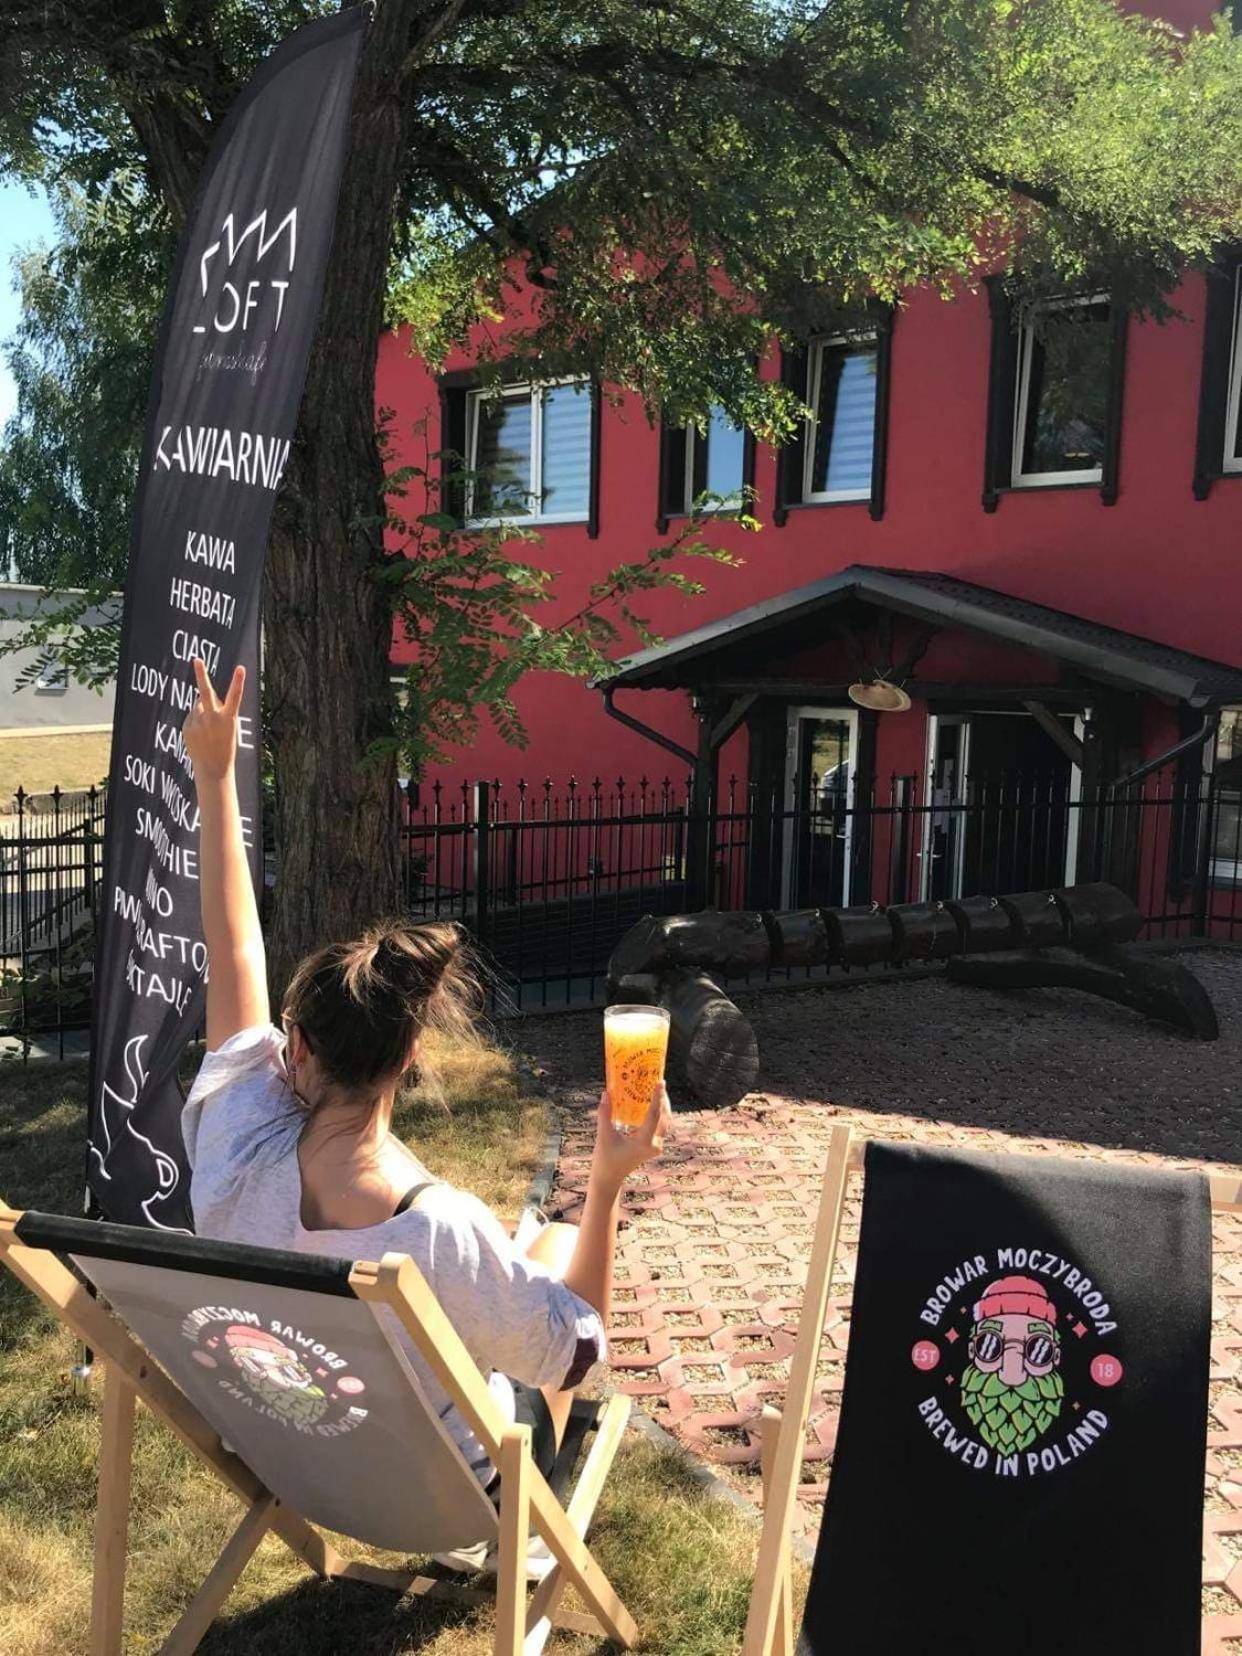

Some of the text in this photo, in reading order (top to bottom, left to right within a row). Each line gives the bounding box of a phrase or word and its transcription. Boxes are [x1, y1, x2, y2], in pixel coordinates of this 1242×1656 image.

[184, 530, 236, 575] KAWA
[170, 576, 237, 630] HERBATA
[130, 662, 169, 701] LODY
[124, 754, 156, 795] SOKI
[920, 1248, 1119, 1336] BROWAR MOCZYBRODA
[914, 1349, 936, 1363] EST
[1098, 1364, 1114, 1379] 18
[918, 1396, 1110, 1477] BREWED IN POLAND
